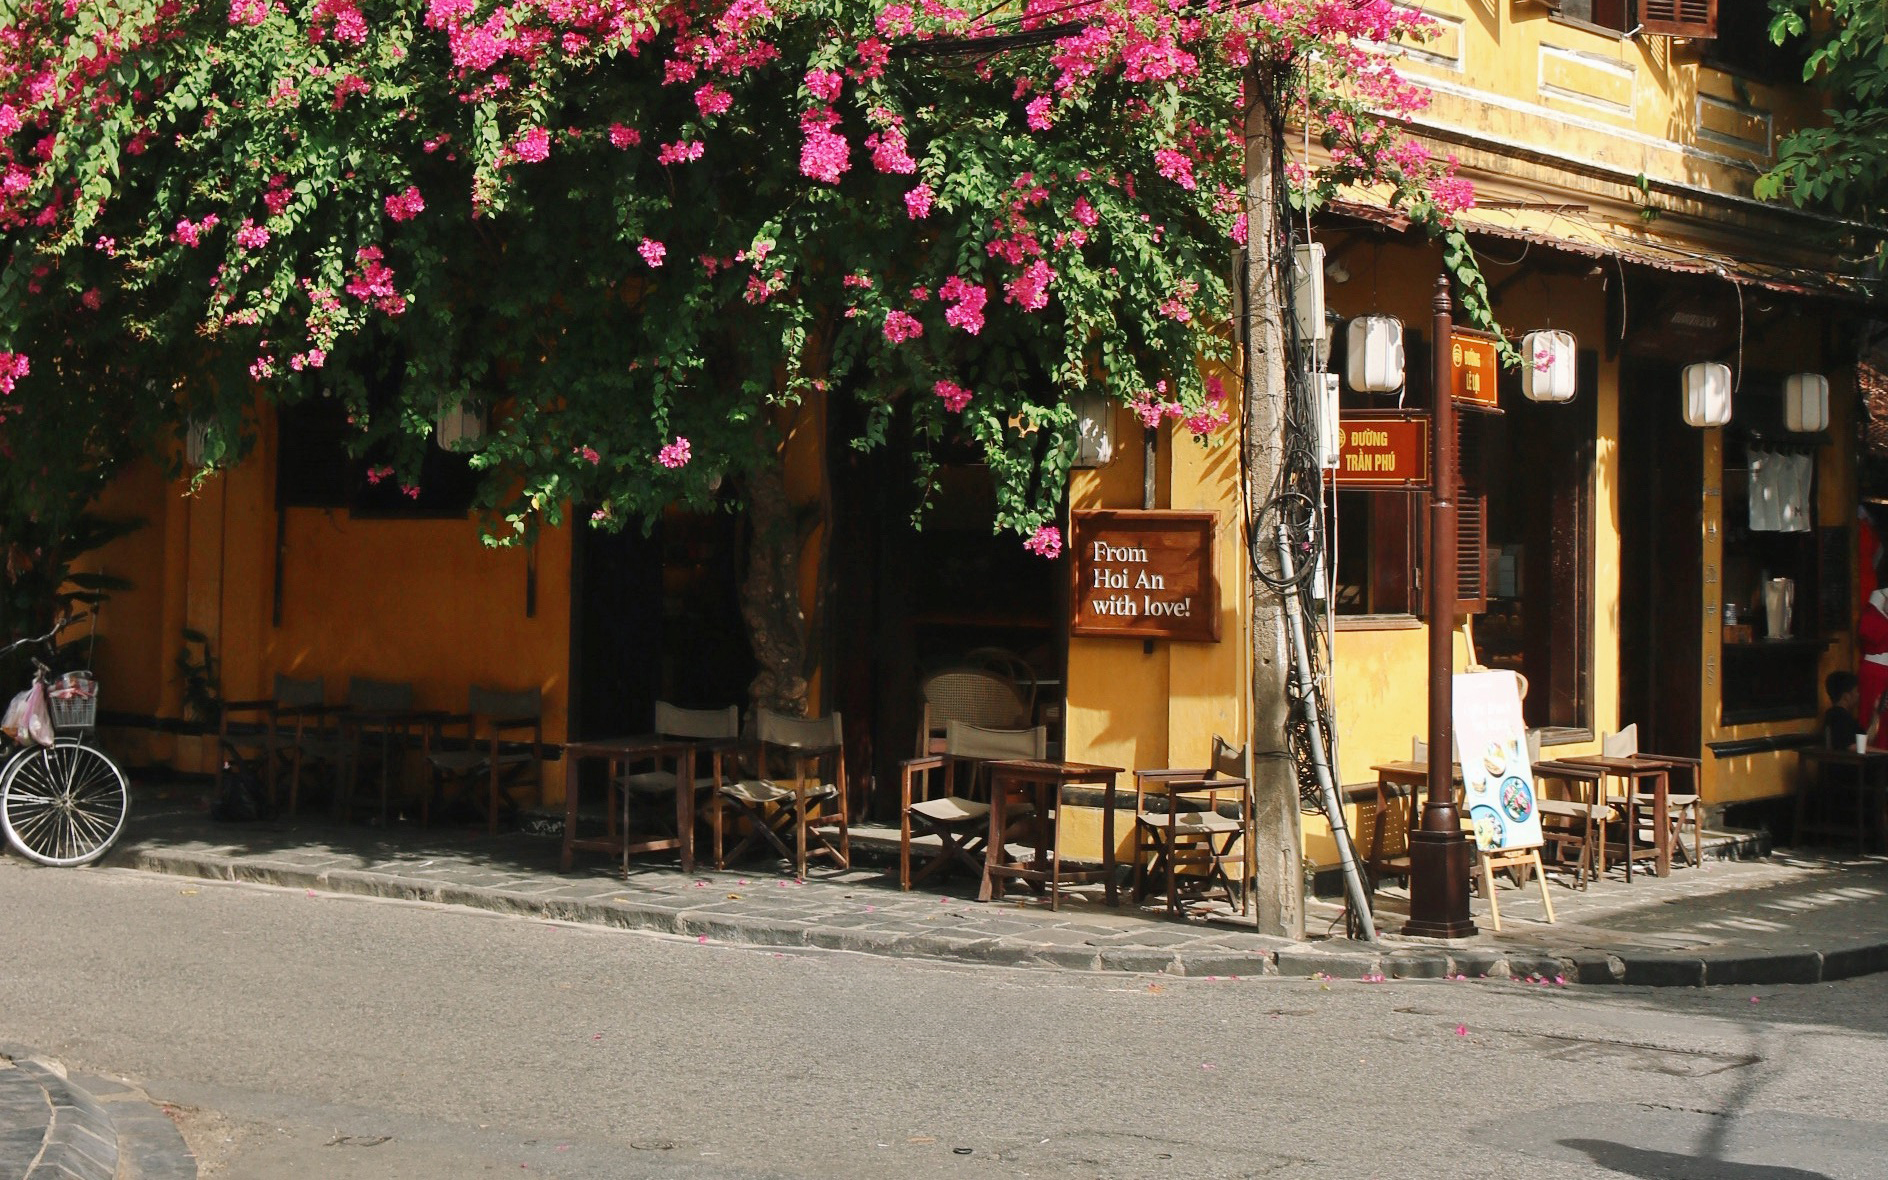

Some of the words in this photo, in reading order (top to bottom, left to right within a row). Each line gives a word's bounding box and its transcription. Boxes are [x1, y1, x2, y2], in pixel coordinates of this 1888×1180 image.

[1351, 428, 1388, 446] ĐƯỜNG
[1345, 448, 1373, 472] TRẦN
[1374, 451, 1396, 472] PHÚ
[1093, 541, 1149, 563] From
[1093, 568, 1129, 589] Hoi
[1134, 569, 1166, 590] An
[1092, 594, 1138, 616] with
[1144, 595, 1191, 618] love!
